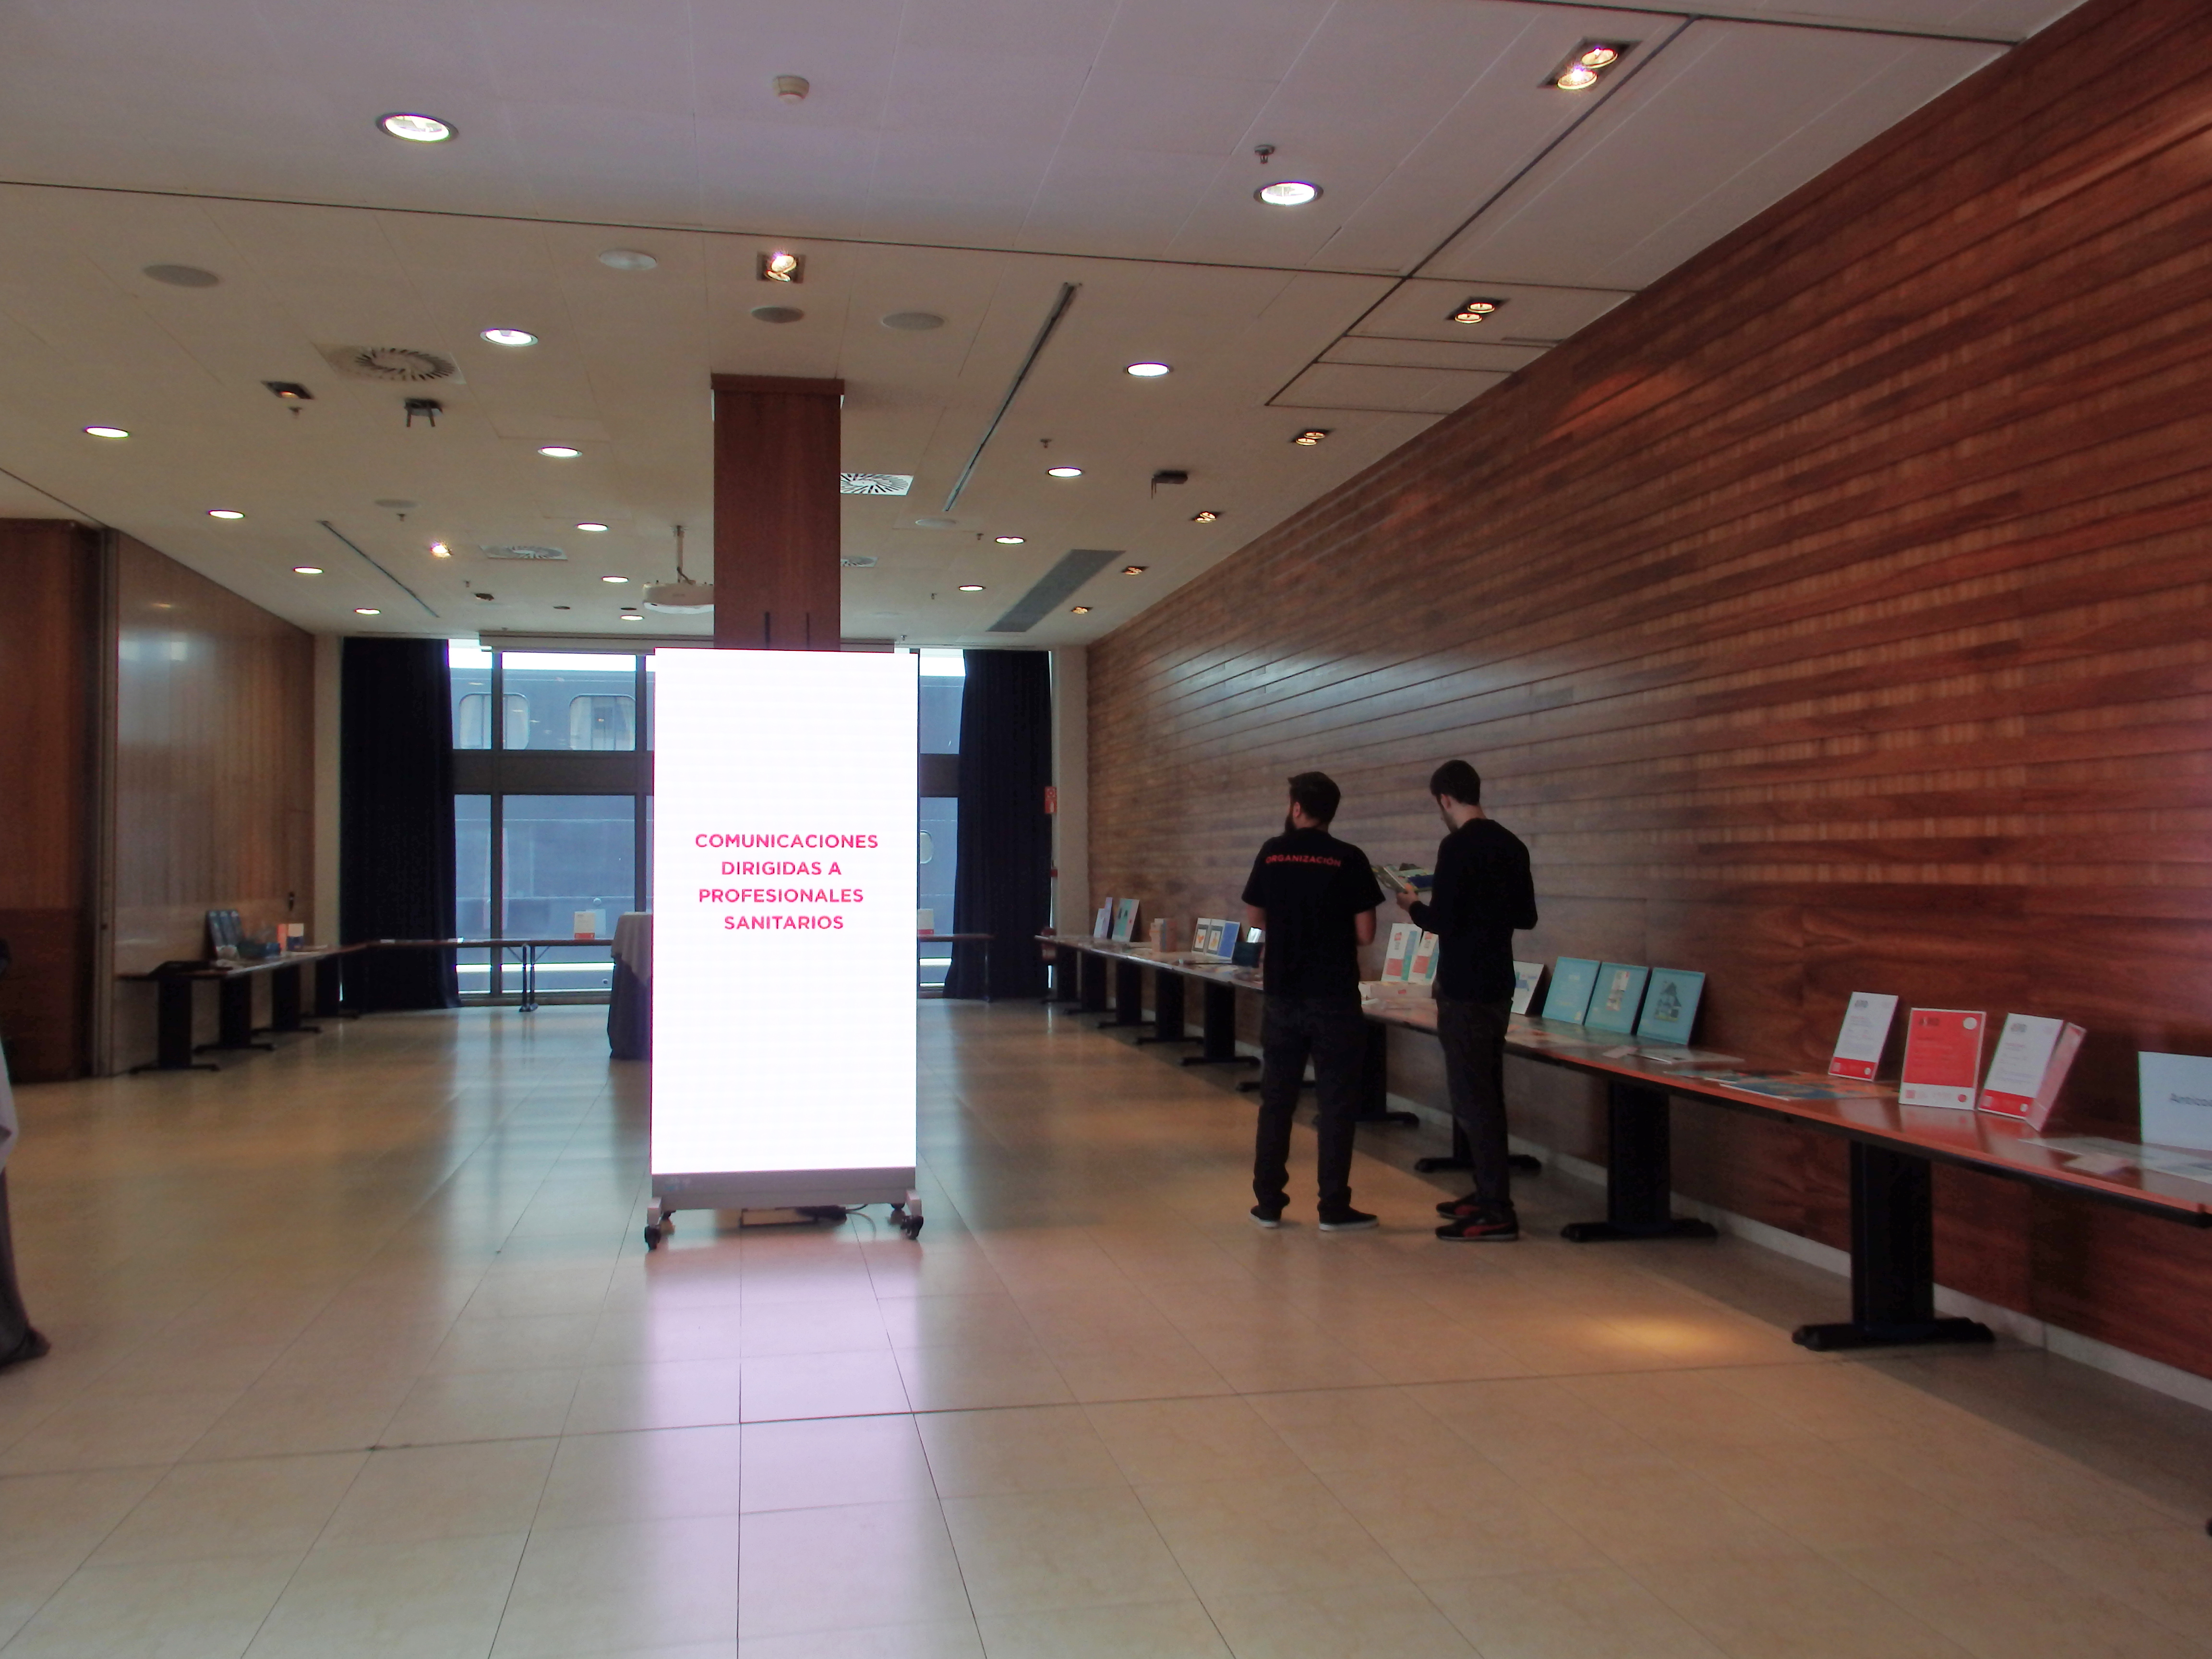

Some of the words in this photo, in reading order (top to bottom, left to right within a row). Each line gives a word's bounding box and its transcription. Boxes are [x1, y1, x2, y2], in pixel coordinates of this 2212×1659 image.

[695, 833, 878, 848] COMUNICACIONES
[1265, 854, 1341, 866] ORGANIZACIÓN
[721, 861, 822, 875] DIRIGIDAS
[828, 861, 842, 875] A
[699, 889, 864, 903] PROFESIONALES
[724, 915, 843, 929] SANITARIOS
